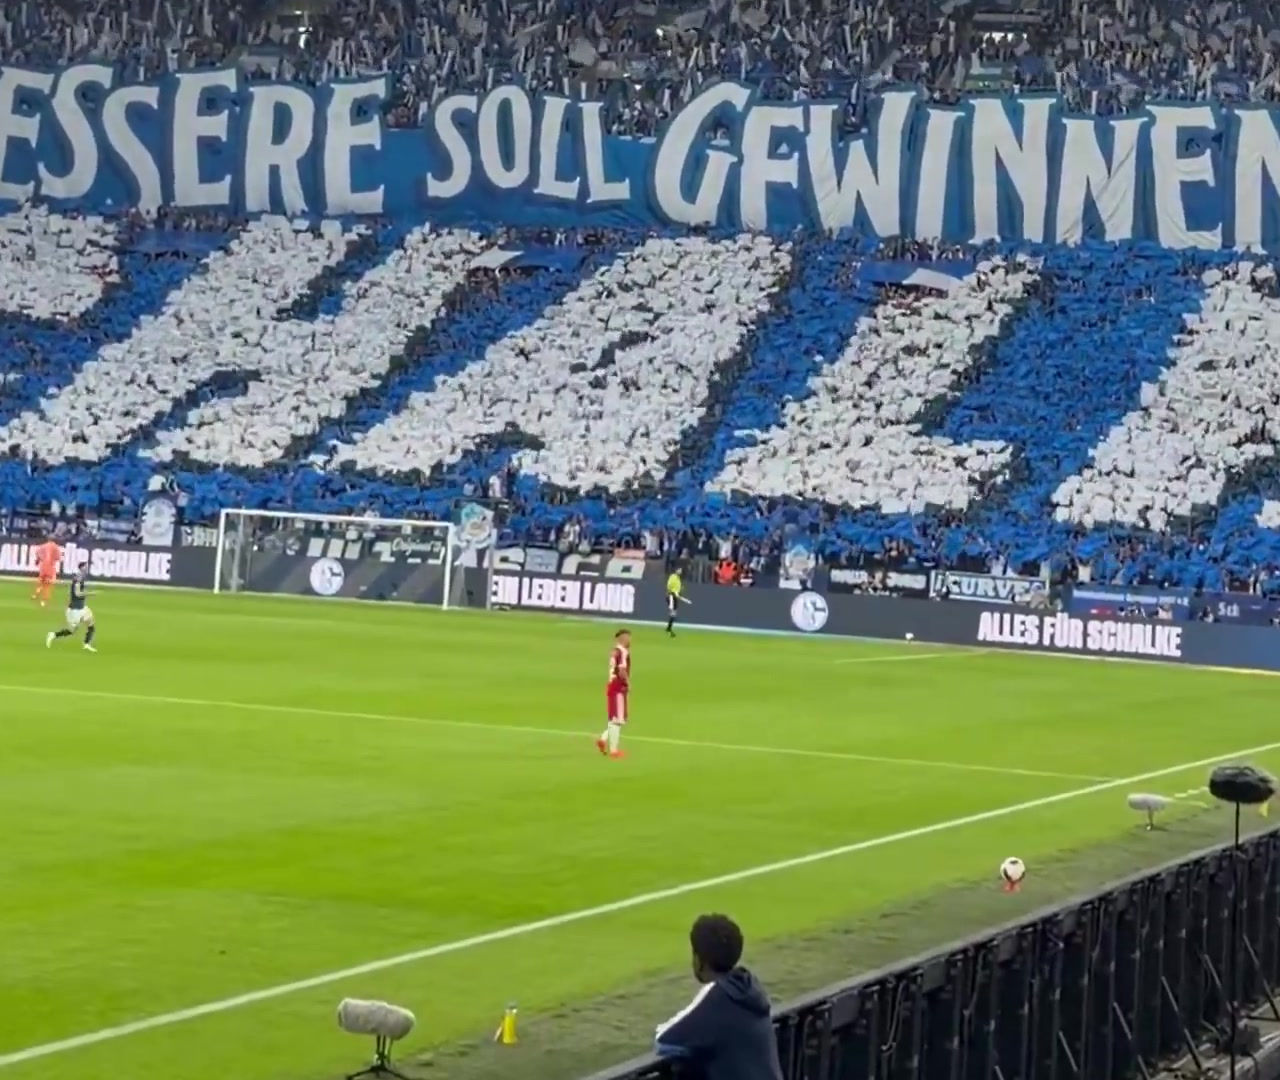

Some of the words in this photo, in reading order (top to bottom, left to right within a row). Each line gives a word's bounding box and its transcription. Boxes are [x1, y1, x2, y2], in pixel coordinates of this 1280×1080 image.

[426, 84, 632, 202] SOLL
[521, 577, 580, 610] LEBEN
[582, 581, 634, 613] LANG
[977, 612, 1039, 645] ALLES
[1043, 612, 1084, 649] FÜR
[1087, 620, 1182, 657] SCHALKE
